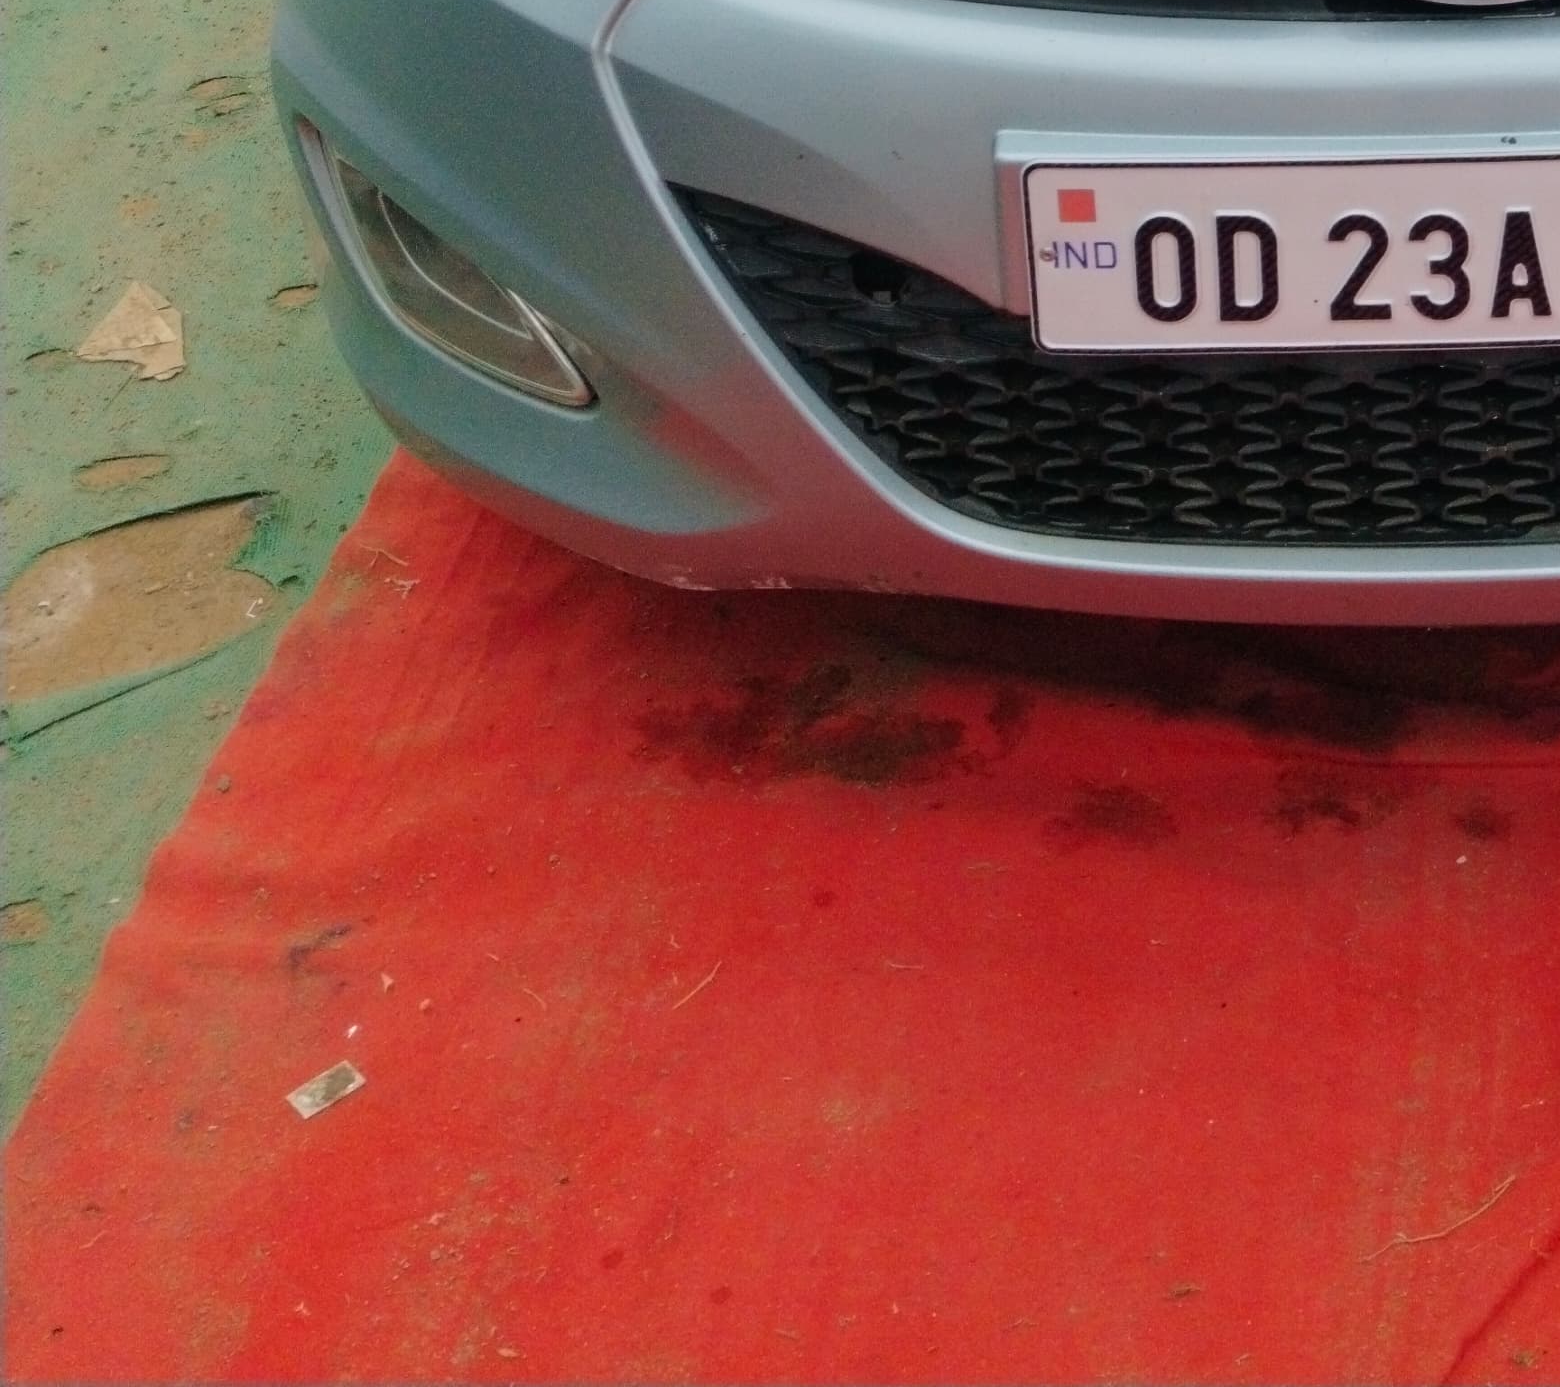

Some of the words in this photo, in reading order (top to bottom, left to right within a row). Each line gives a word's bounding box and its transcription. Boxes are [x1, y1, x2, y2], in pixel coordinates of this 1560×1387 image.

[1052, 241, 1117, 269] IND
[1134, 211, 1279, 323] OD
[1327, 210, 1553, 323] 23A
